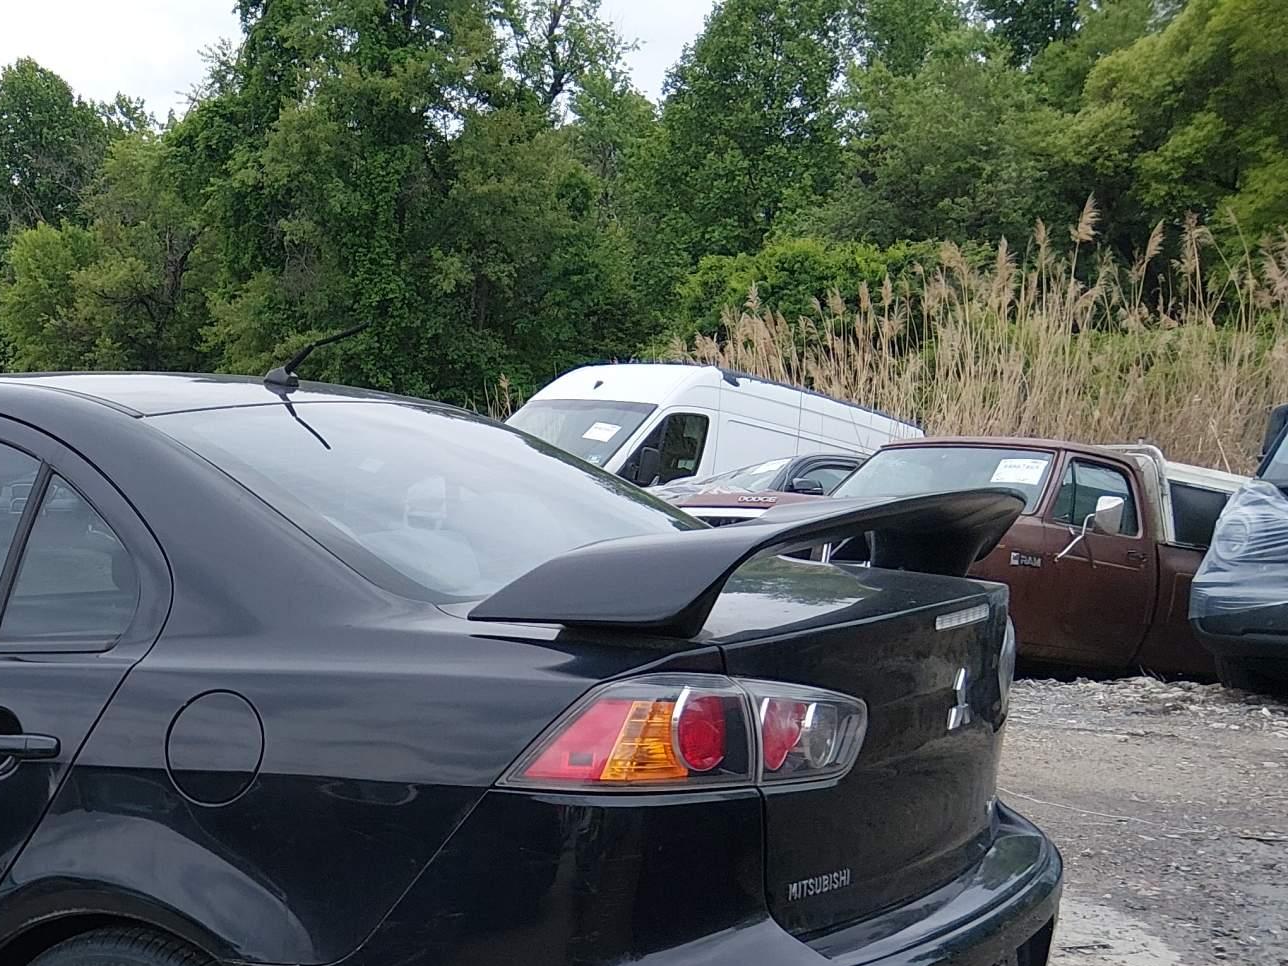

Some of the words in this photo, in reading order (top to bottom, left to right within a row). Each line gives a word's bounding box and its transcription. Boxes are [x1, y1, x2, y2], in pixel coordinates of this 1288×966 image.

[737, 495, 777, 503] DODGE
[1021, 554, 1041, 567] RAM
[788, 868, 850, 901] MITSUBISHI
